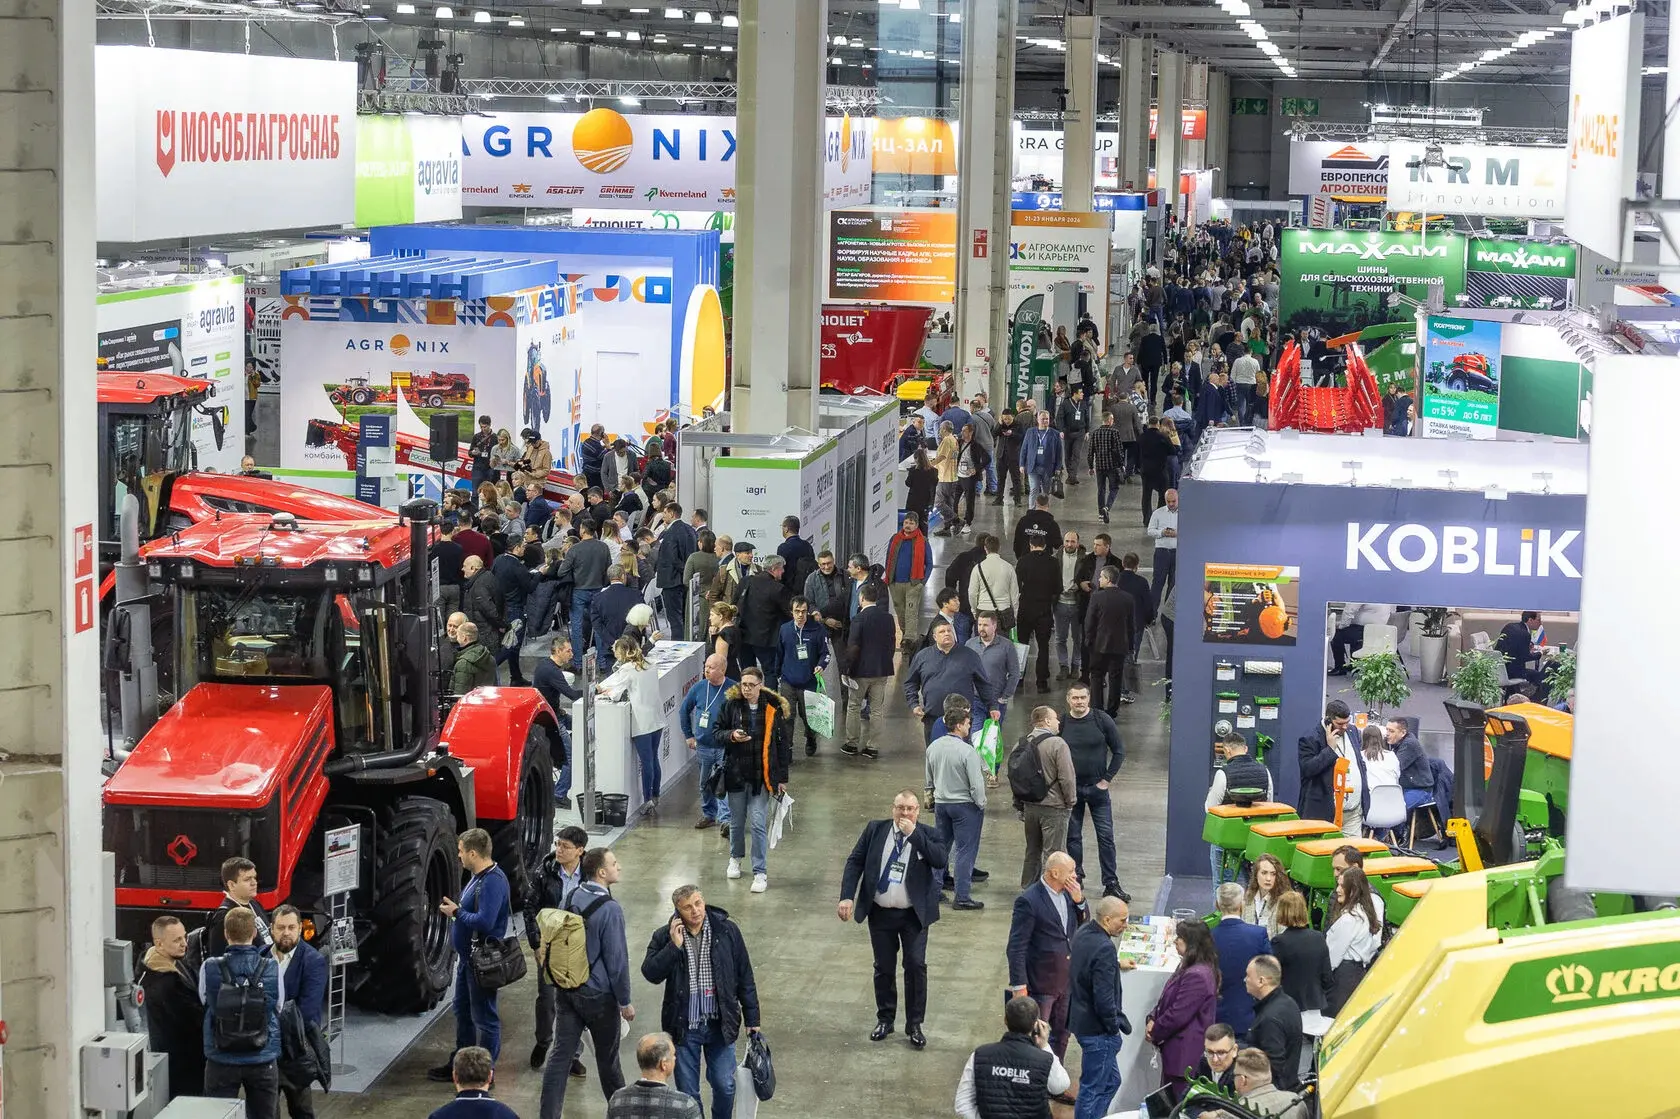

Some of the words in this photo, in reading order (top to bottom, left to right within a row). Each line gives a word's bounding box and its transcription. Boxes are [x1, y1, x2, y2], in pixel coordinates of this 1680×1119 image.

[181, 111, 341, 162] МОСОБЛАГРОСНАБ
[1054, 137, 1113, 151] GUP
[418, 153, 460, 195] agravia
[1321, 171, 1389, 182] ЕВРОПЕЙСК
[660, 189, 707, 199] Kverneland
[1320, 183, 1388, 194] АГРОТЕХНИ
[1407, 190, 1555, 208] innovation
[1028, 243, 1095, 254] АГРОКАМПУС
[1299, 238, 1448, 261] MAXAM
[1038, 253, 1080, 261] КАРЬЕРА
[1477, 248, 1566, 269] MAXAM
[1356, 265, 1388, 275] ШИНЫ
[1299, 273, 1321, 284] ДЛЯ
[1322, 273, 1445, 287] СЕЛЬСКОХОЗЯЙСТВЕННОЙ
[245, 287, 267, 296] ARTS
[1350, 284, 1393, 294] ТЕХНИКИ
[201, 302, 235, 334] agravia
[304, 451, 340, 460] комбайн
